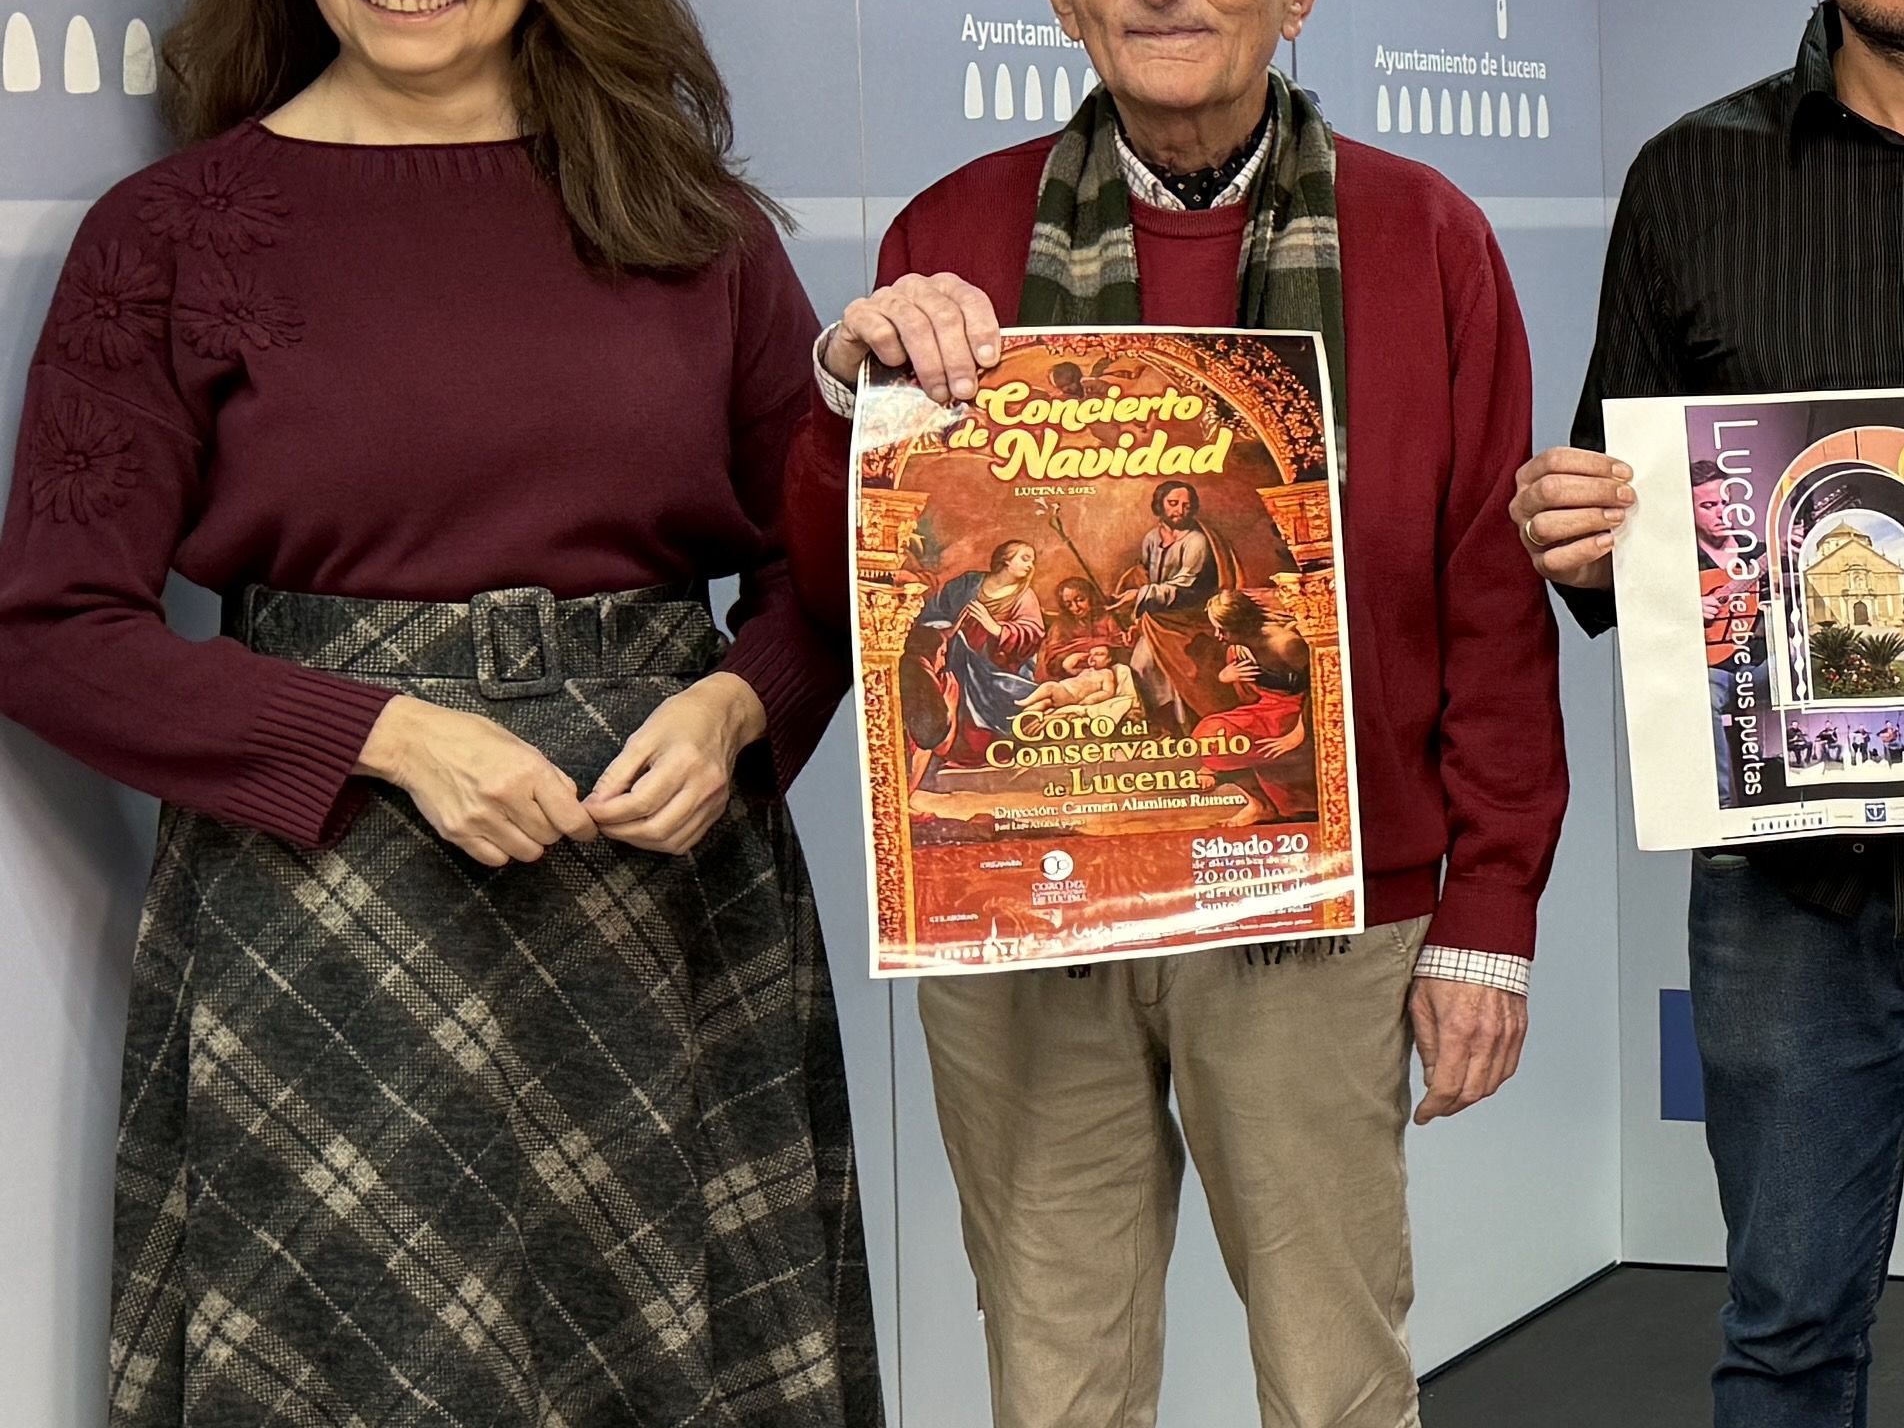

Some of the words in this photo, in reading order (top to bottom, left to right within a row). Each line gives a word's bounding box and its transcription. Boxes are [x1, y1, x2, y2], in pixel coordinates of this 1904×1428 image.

[1375, 44, 1477, 75] Ayuntamiento
[1480, 51, 1497, 76] de
[1501, 55, 1547, 80] Lucena
[976, 382, 1202, 431] Concierto
[949, 419, 988, 449] de
[991, 427, 1233, 480] Navidad
[1014, 487, 1065, 497] LUCENA
[1713, 420, 1759, 581] Lucena
[1728, 590, 1751, 611] te
[1729, 613, 1752, 665] abre
[1734, 670, 1754, 708] sus
[1012, 711, 1114, 742] Coro
[1121, 721, 1148, 736] del
[986, 728, 1250, 768] Conservatorio
[1736, 713, 1763, 796] puertas
[1044, 782, 1066, 797] de
[1071, 768, 1199, 795] Lucena
[1062, 801, 1118, 815] Carmen
[1121, 797, 1187, 811] Alaminos
[1192, 834, 1273, 858] Sábado
[1276, 834, 1309, 853] 20
[1194, 868, 1253, 884] 20:00
